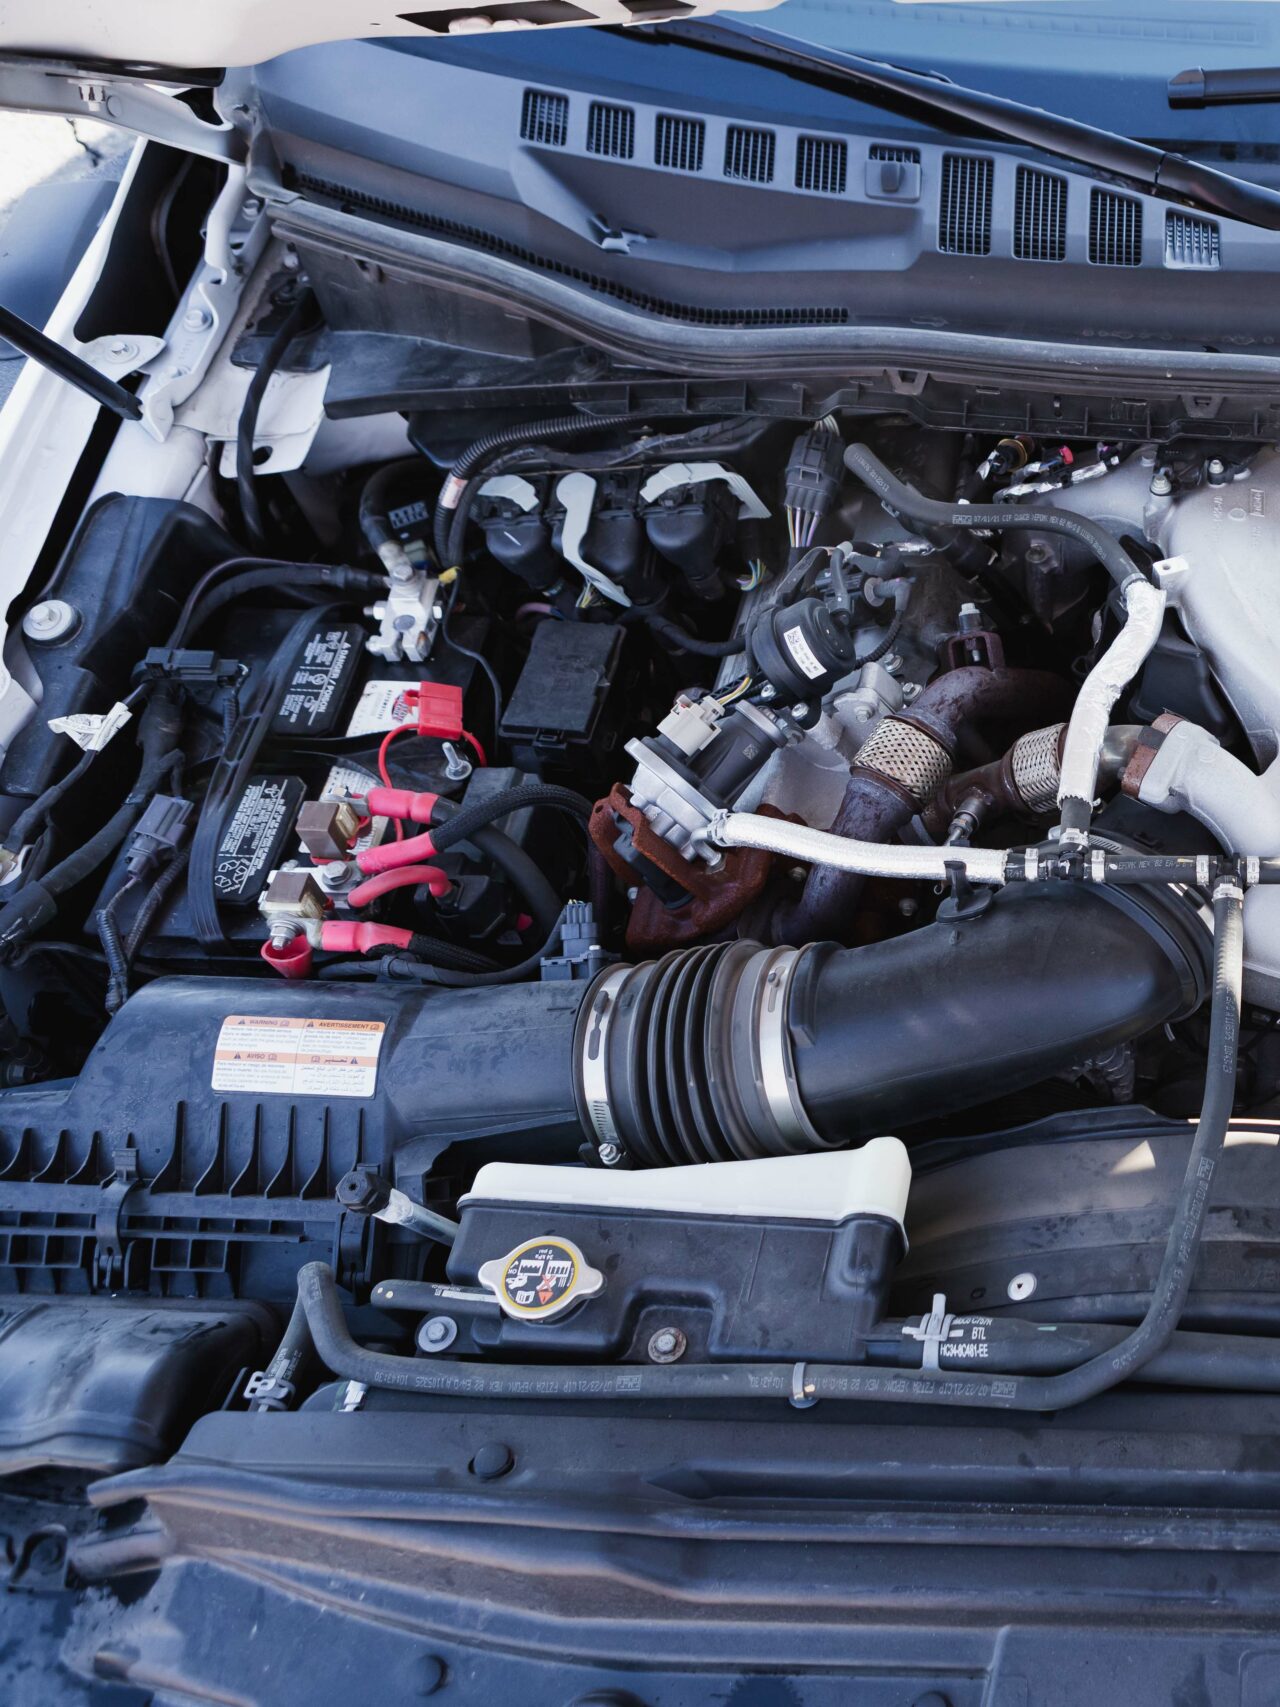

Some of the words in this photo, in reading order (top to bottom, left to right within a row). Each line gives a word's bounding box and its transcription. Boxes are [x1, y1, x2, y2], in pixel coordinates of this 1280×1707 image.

[330, 648, 349, 681] DANGER
[317, 684, 335, 714] POISON
[319, 1022, 369, 1030] AVERTISSEMENT
[971, 1326, 986, 1341] BTL
